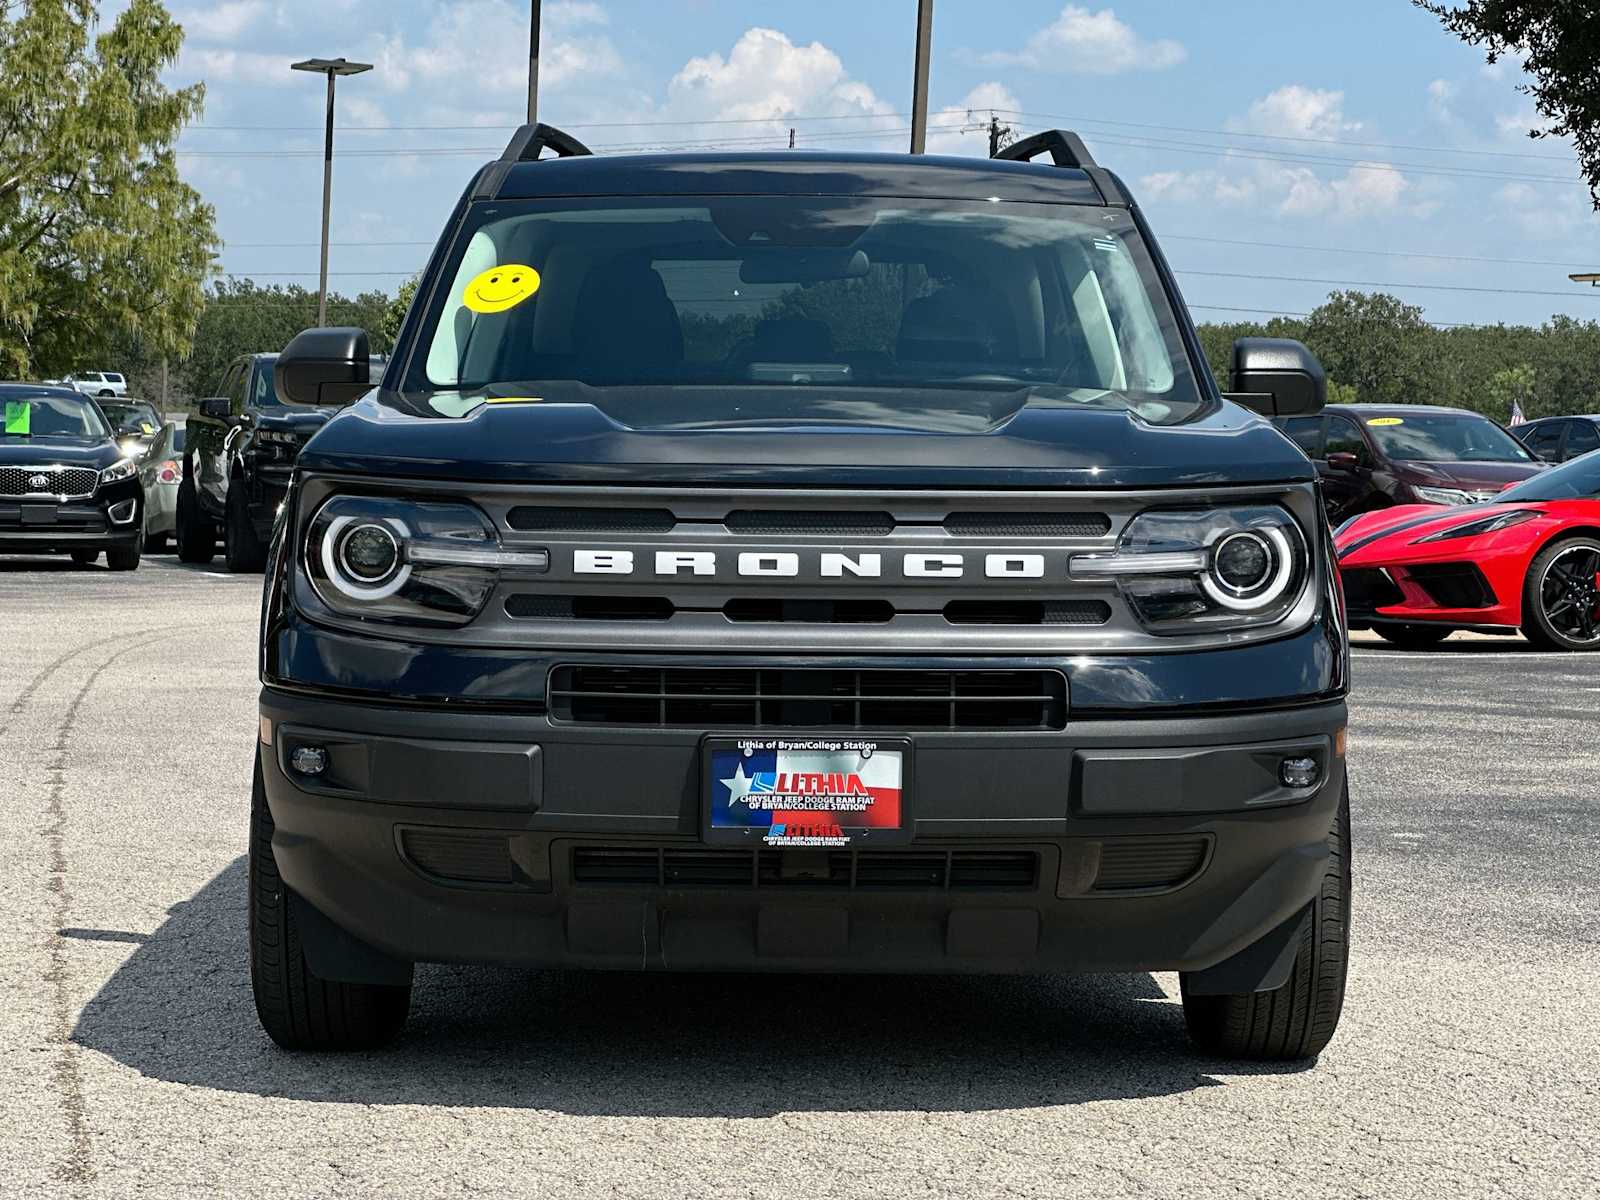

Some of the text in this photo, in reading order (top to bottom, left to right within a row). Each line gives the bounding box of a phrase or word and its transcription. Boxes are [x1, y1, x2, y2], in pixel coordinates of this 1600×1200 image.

[573, 549, 1045, 578] BRONCO
[737, 741, 877, 751] Lithia of Bryan/College Station
[776, 773, 868, 795] LITHIA
[740, 795, 783, 803] CHRYSLER
[804, 796, 835, 804] DODGE
[857, 797, 875, 805] FIAT
[748, 802, 866, 811] OF BRYAN/COLLEGE STATION
